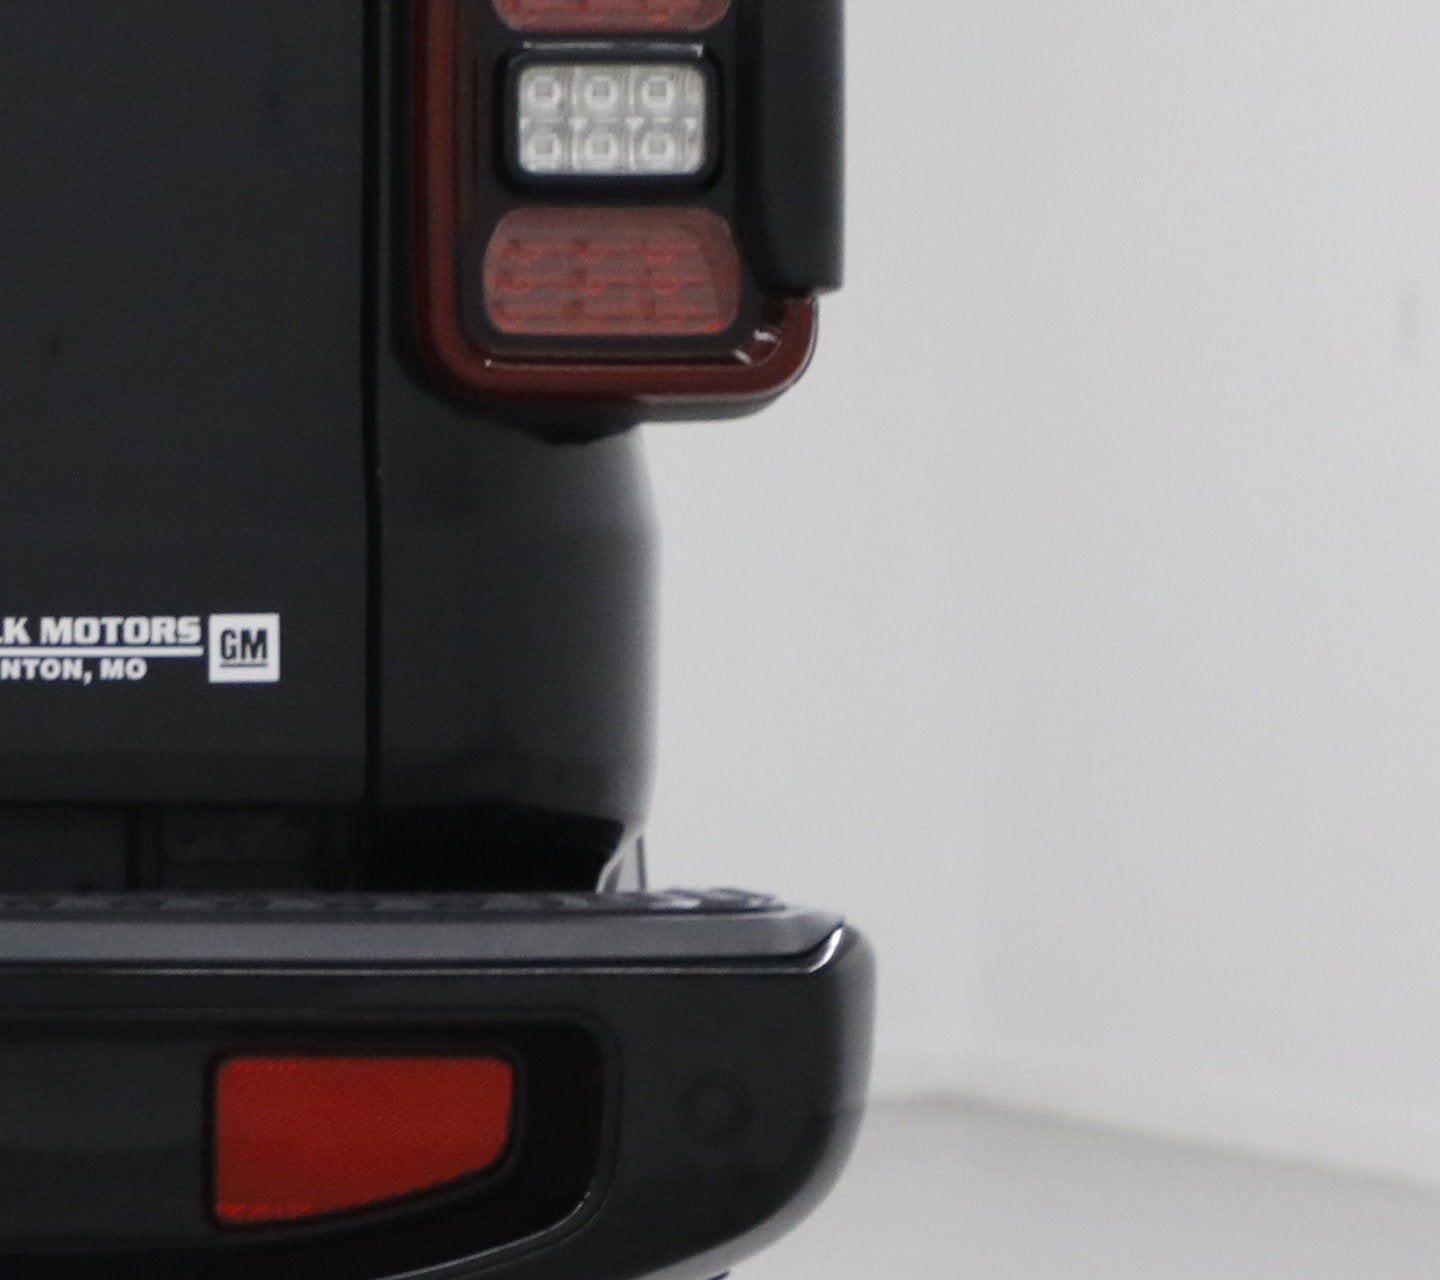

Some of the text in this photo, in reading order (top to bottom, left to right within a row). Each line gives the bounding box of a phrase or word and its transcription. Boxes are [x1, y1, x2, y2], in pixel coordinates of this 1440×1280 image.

[39, 616, 202, 645] MOTORS
[219, 628, 268, 661] GM
[99, 658, 148, 681] MO
